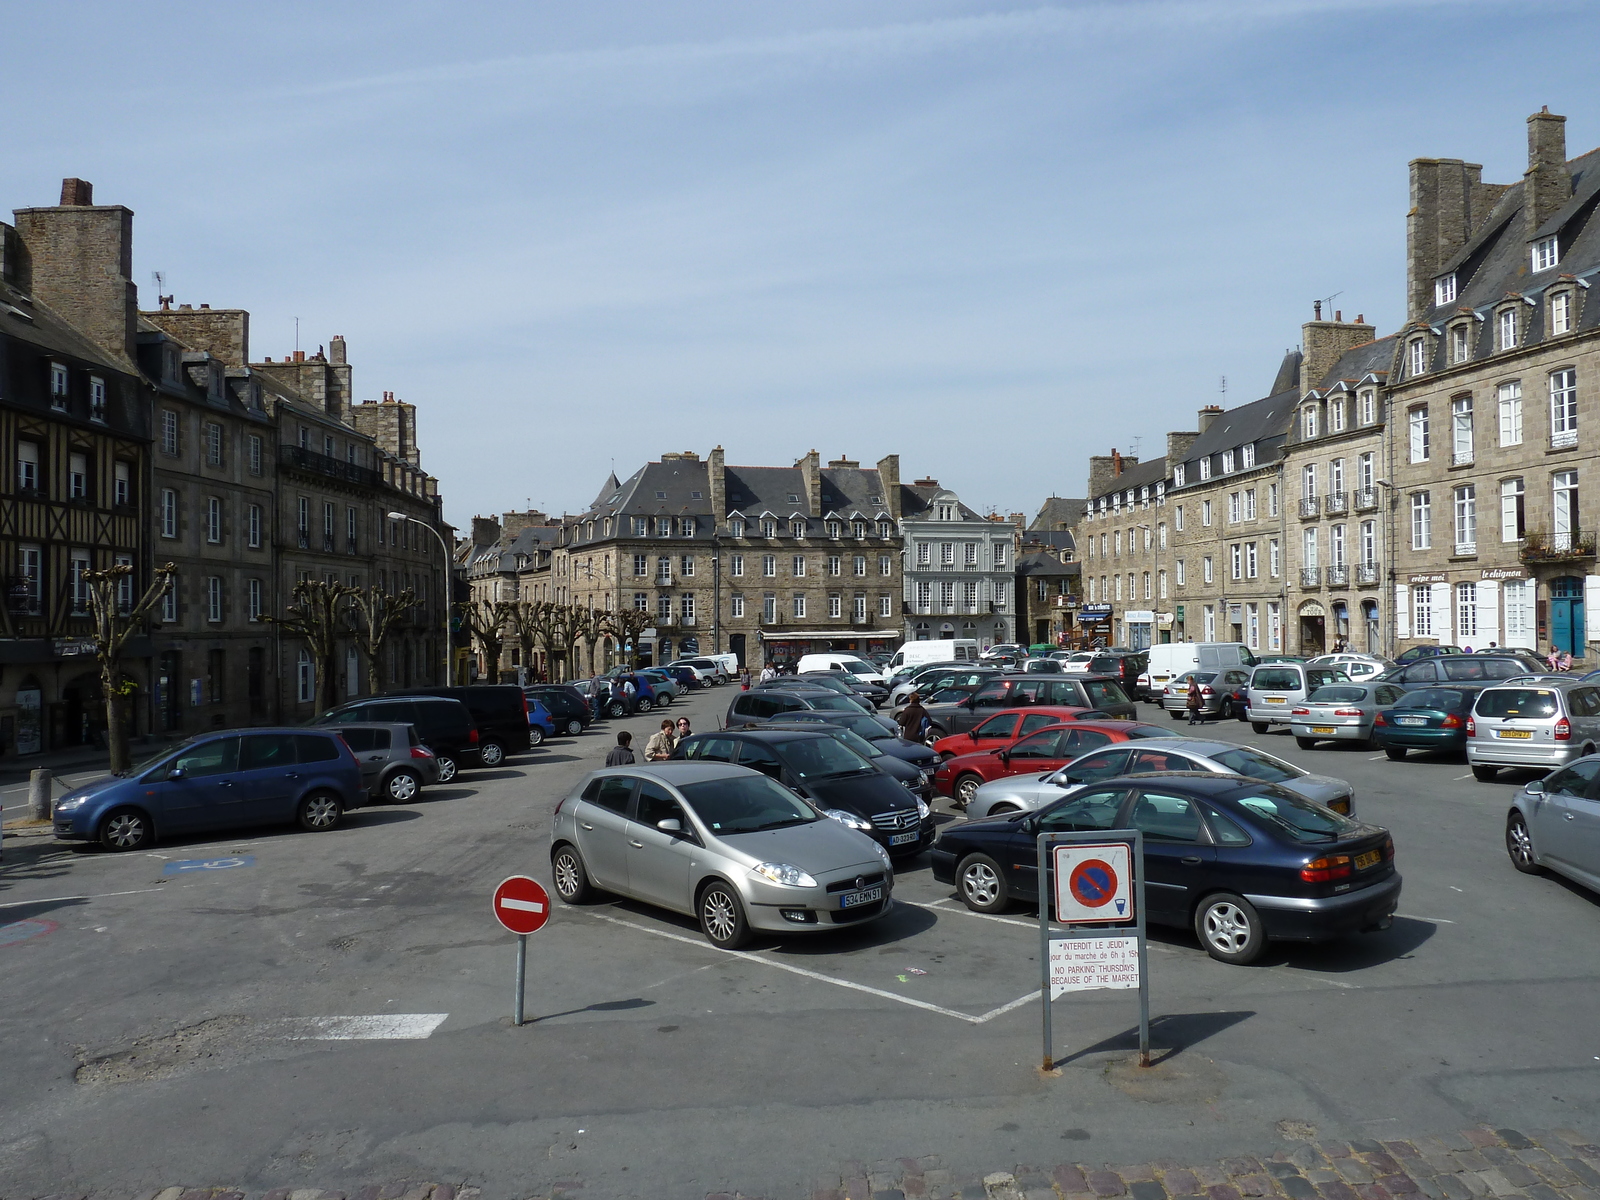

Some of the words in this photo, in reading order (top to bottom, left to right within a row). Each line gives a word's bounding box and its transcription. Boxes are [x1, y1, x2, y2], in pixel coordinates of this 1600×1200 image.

[1431, 573, 1446, 582] moi
[1489, 569, 1522, 579] chignon
[845, 895, 859, 906] 534
[872, 888, 881, 899] 91
[1063, 942, 1092, 951] INTERDIT
[1095, 941, 1103, 950] LE
[1106, 941, 1125, 949] JEUDI
[1050, 954, 1061, 962] jour
[1099, 951, 1108, 959] de
[1110, 950, 1119, 959] 6h
[1128, 949, 1138, 958] 15h
[1054, 966, 1065, 975] NO
[1067, 965, 1095, 974] PARKING
[1098, 964, 1135, 972] THURSDAYS
[1051, 976, 1081, 985] BECAUSE
[1083, 975, 1093, 984] OF
[1096, 975, 1109, 983] THE
[1111, 973, 1139, 982] MARKET
